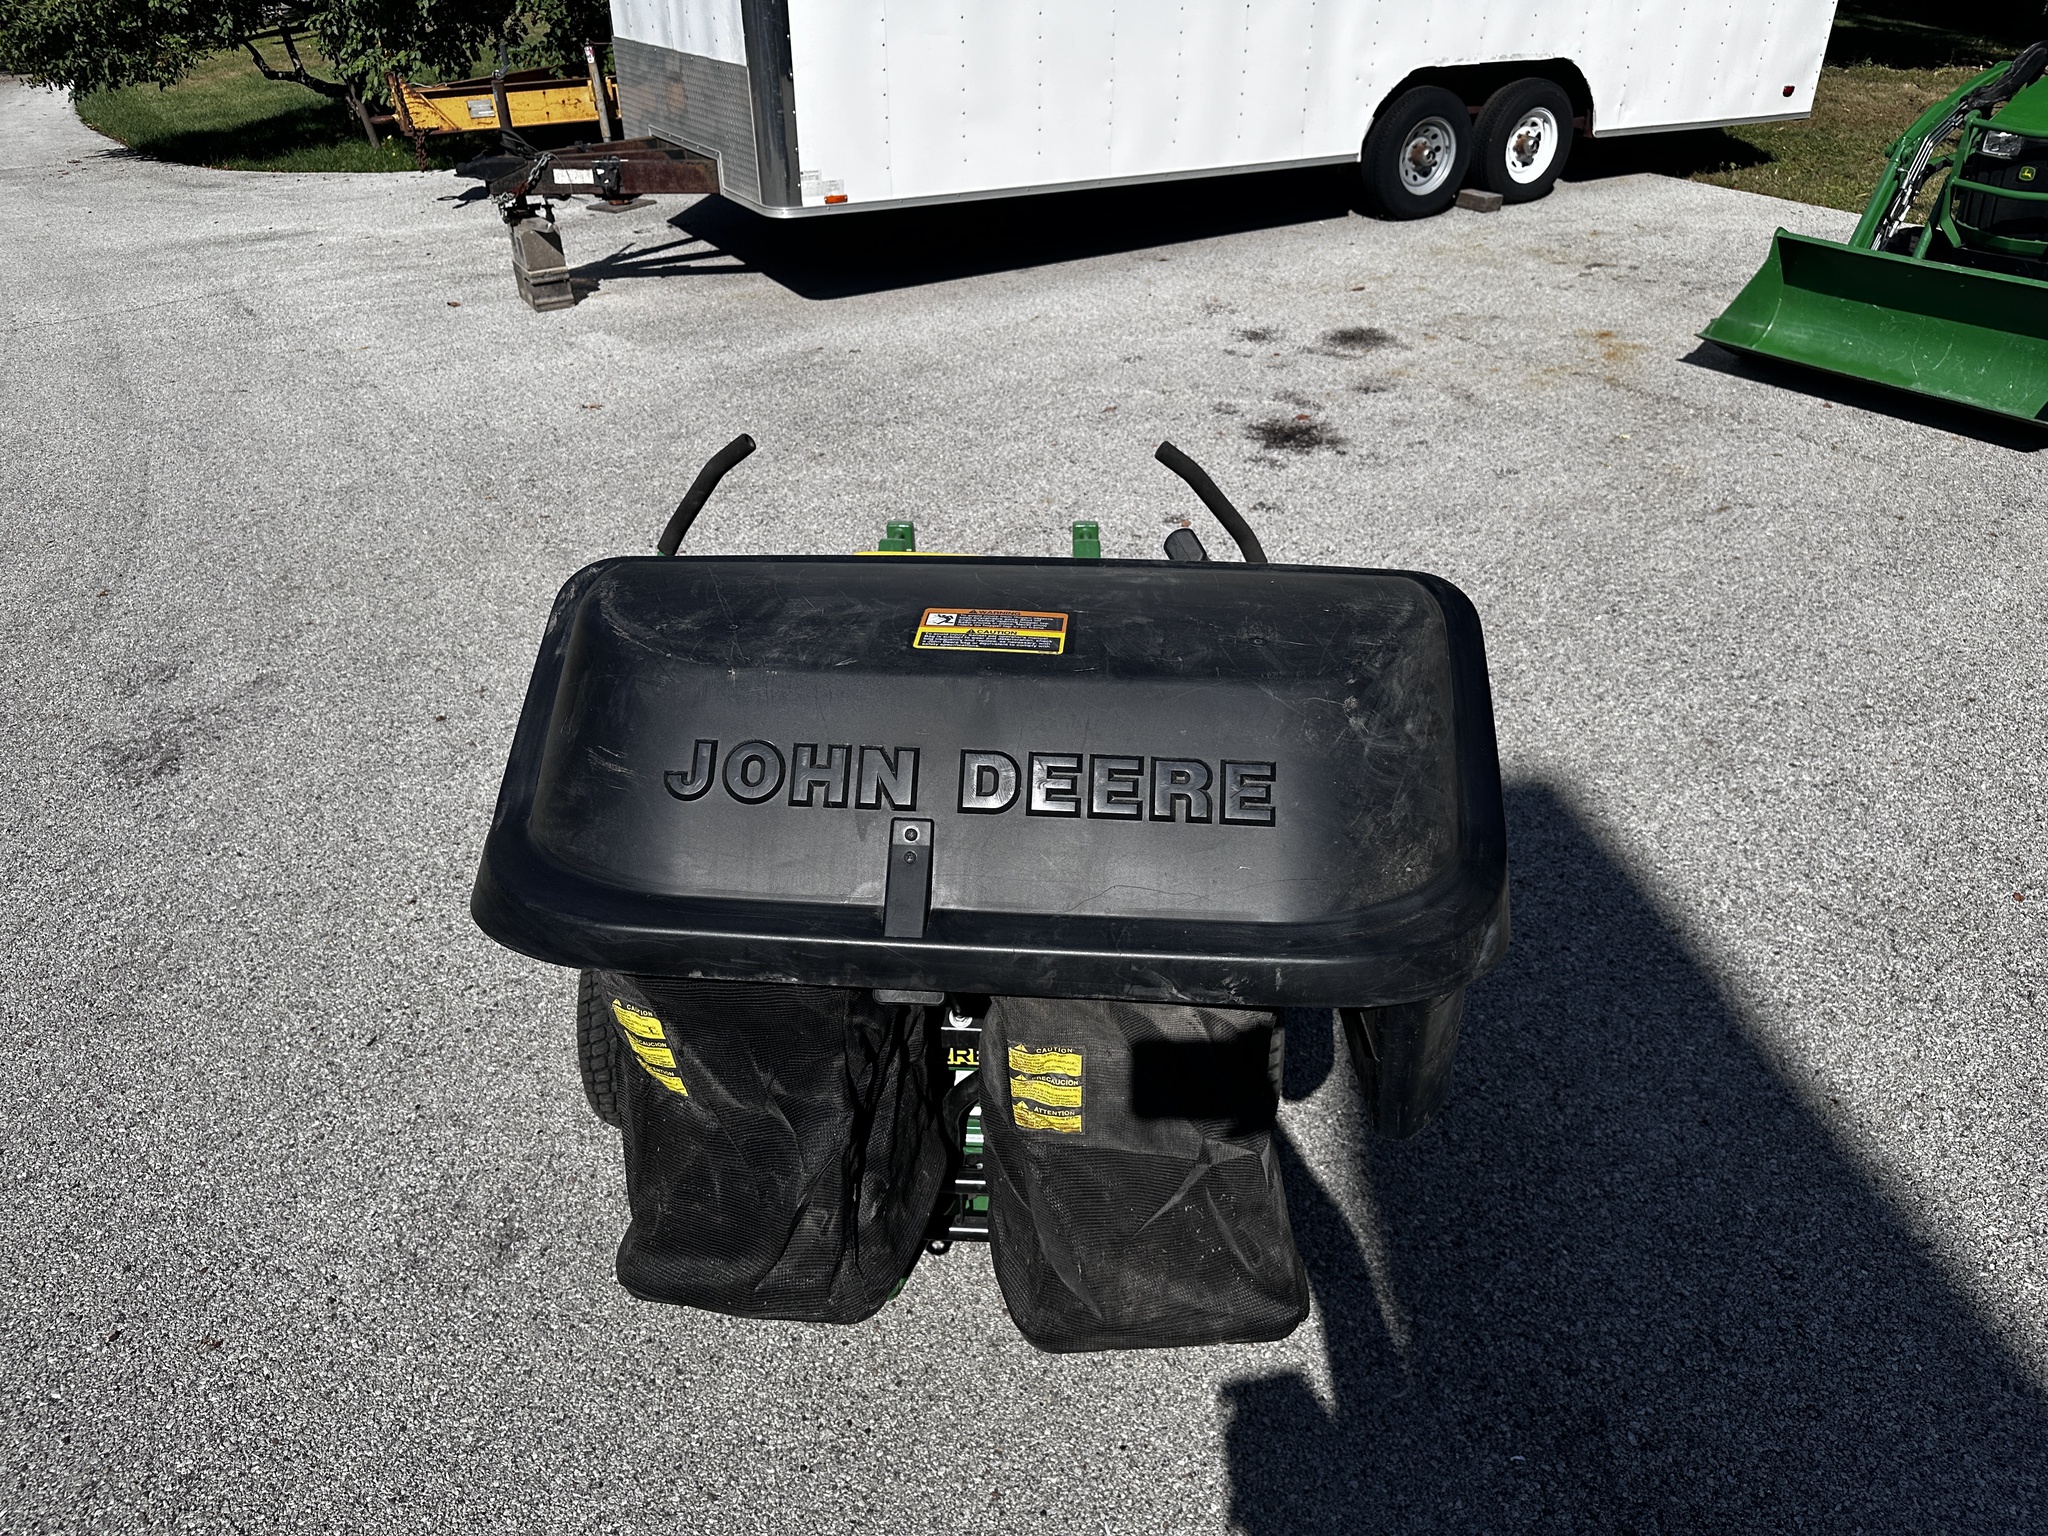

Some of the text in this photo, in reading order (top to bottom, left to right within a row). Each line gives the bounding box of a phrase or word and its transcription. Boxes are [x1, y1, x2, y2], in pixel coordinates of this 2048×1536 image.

[663, 739, 1276, 827] JOHN DEERE
[626, 1004, 654, 1017] CAION
[1036, 1046, 1073, 1054] CAUTION
[1034, 1106, 1075, 1117] ATTENTION
